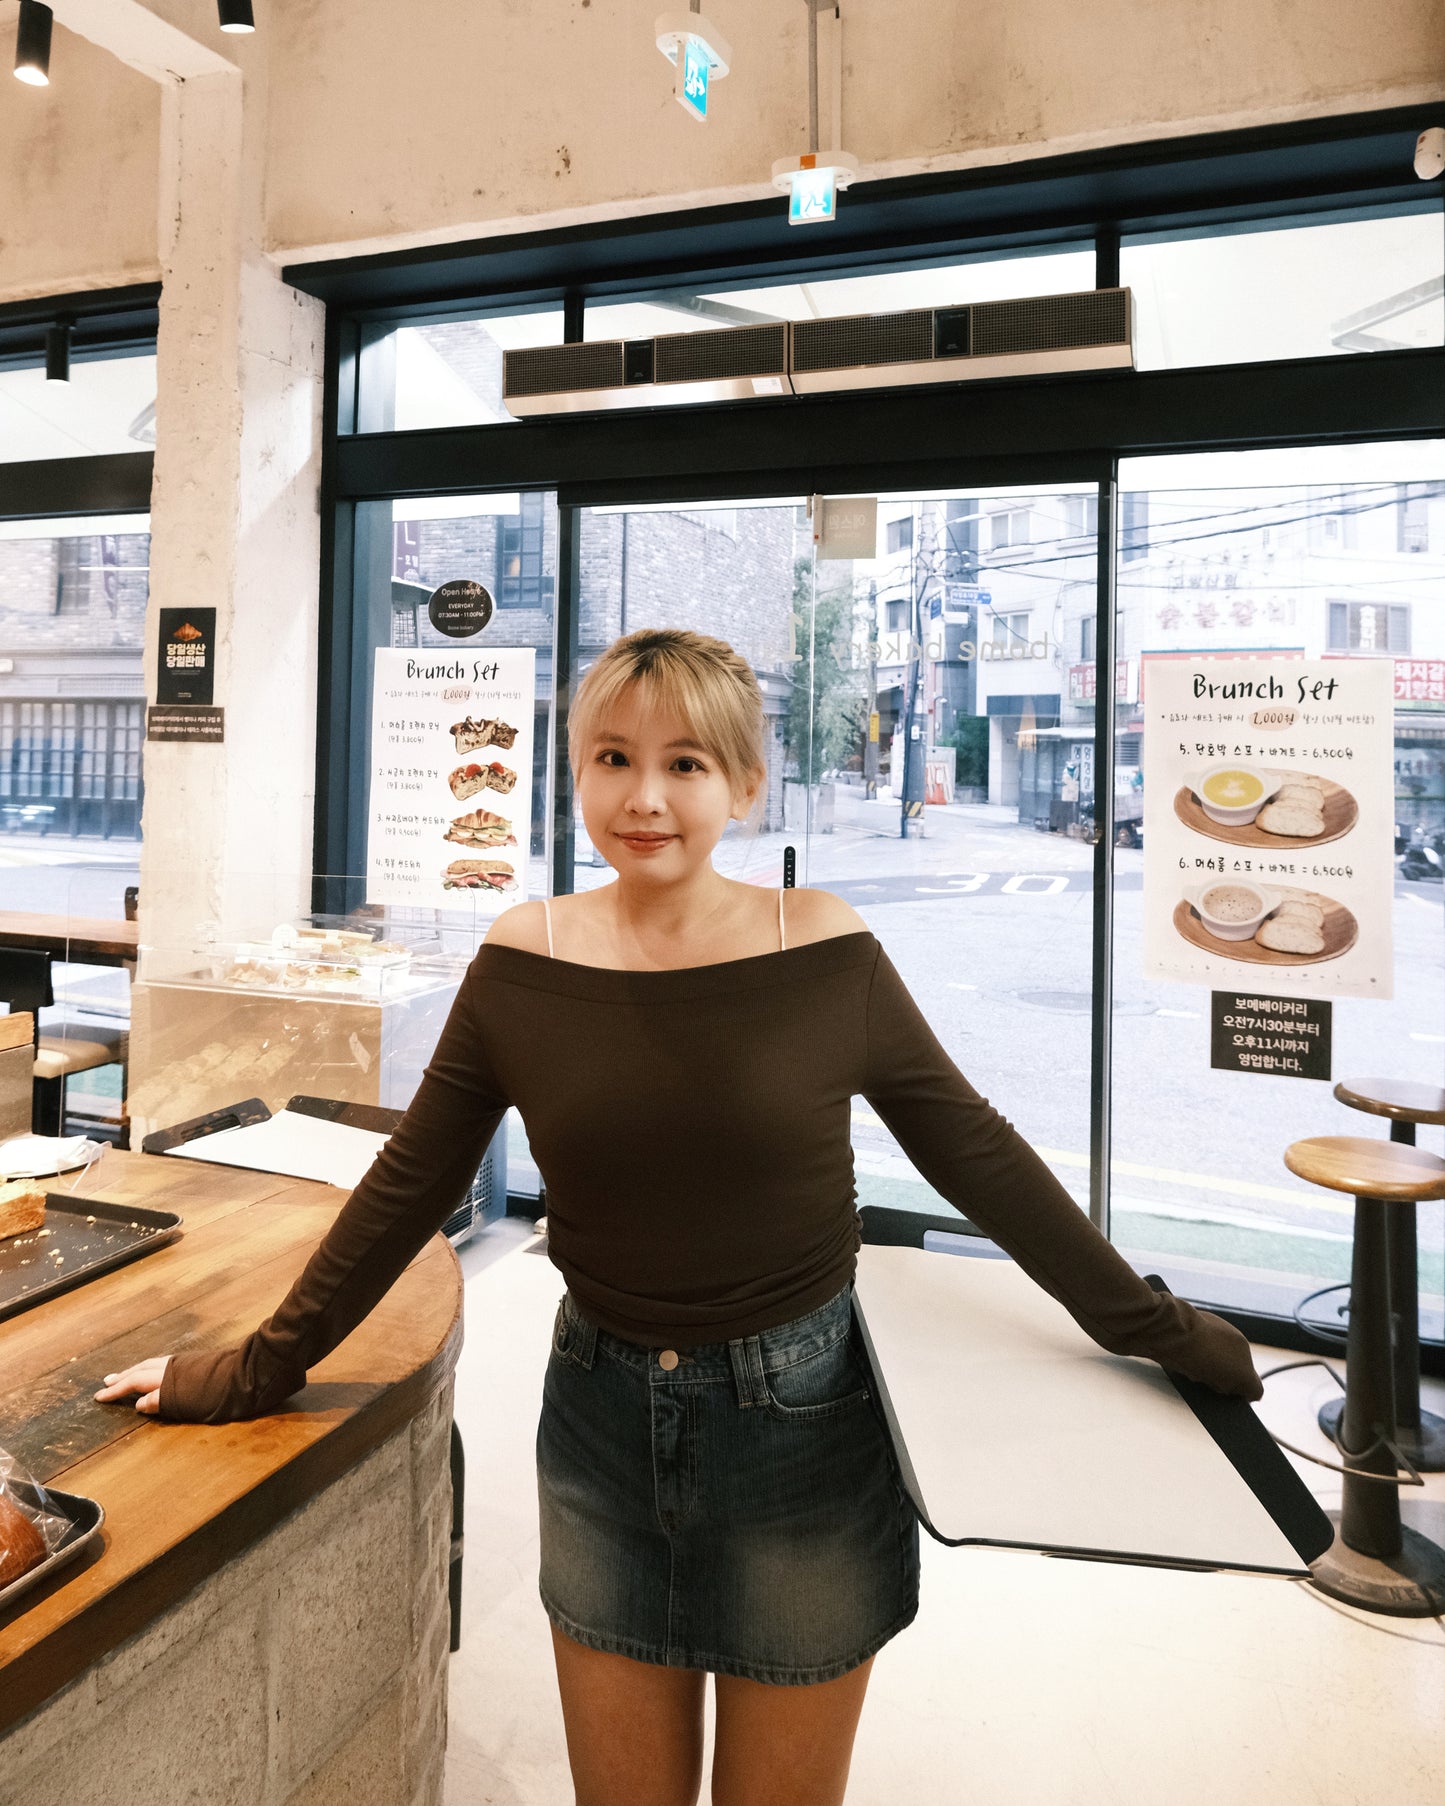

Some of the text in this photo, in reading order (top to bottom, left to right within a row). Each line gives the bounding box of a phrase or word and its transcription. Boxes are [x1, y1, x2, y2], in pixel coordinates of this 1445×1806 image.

[441, 588, 460, 597] Open
[167, 643, 206, 655] 당일생산
[166, 656, 206, 668] 당일판매
[406, 659, 500, 683] Brunch Set
[1193, 673, 1339, 704] Brunch Set
[1179, 743, 1190, 755] 5.
[1195, 743, 1227, 757] 단호박
[1178, 857, 1190, 869] 6.
[915, 871, 1070, 895] 30
[1234, 997, 1308, 1017] 보메베이커리
[1222, 1014, 1320, 1037] 오전7시30분부터
[1231, 1034, 1310, 1054] 오후11시까지
[1238, 1052, 1303, 1072] 영업합니다.
